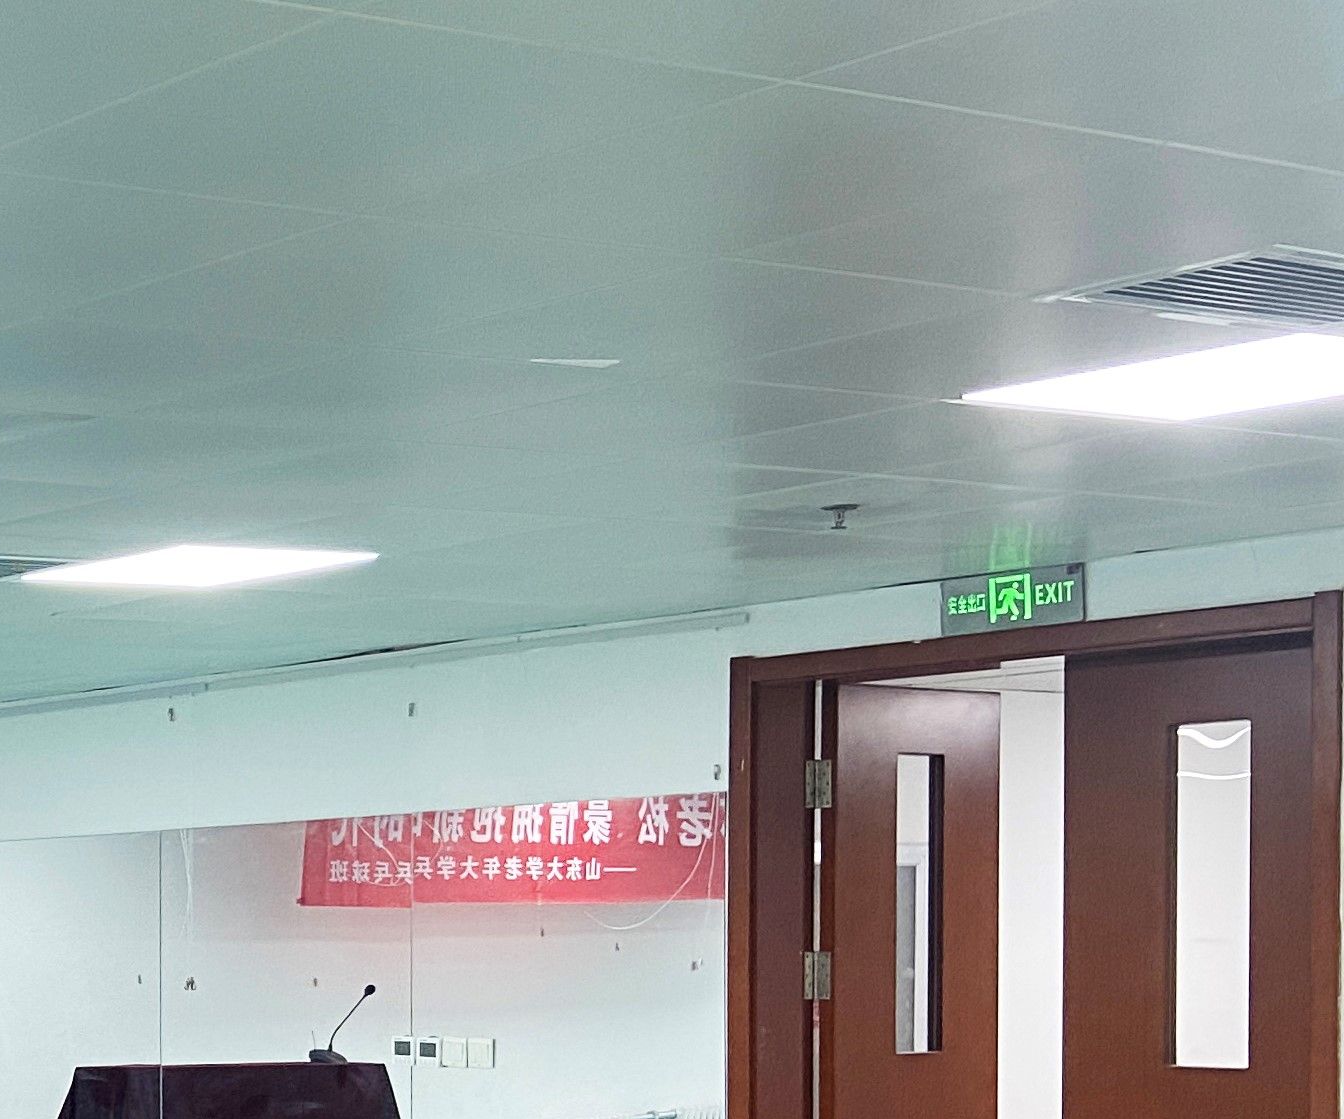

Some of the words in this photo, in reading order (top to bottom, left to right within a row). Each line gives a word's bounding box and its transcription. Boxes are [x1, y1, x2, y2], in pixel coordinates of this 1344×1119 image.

[948, 594, 986, 615] 安全出口
[1034, 580, 1075, 606] EXIT
